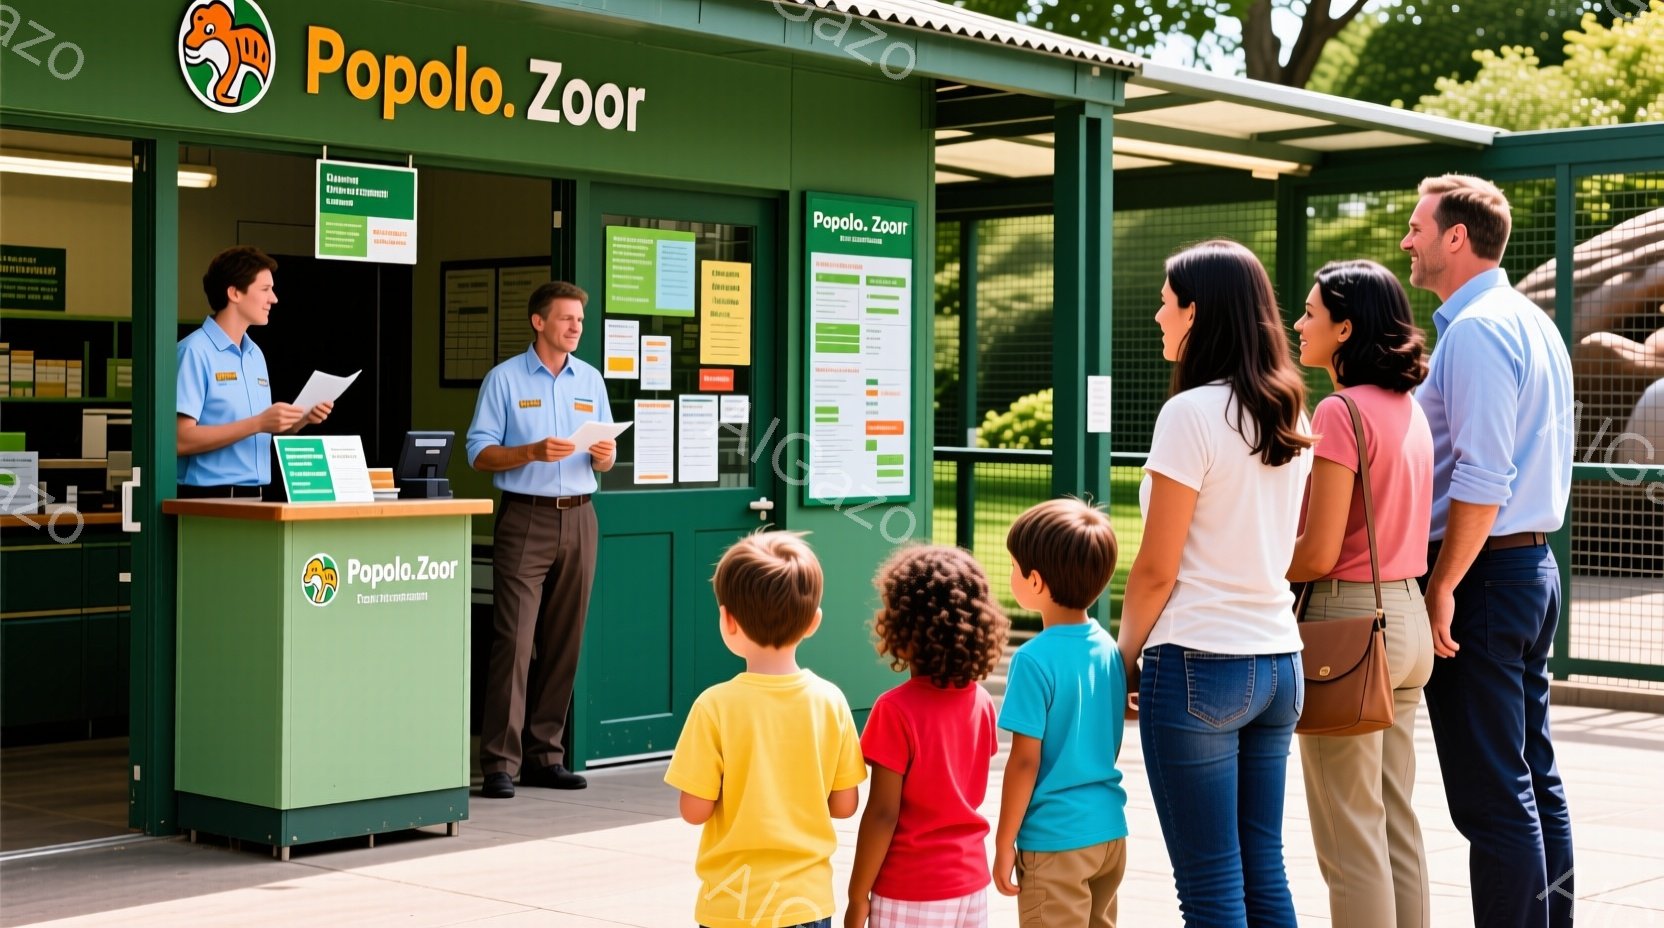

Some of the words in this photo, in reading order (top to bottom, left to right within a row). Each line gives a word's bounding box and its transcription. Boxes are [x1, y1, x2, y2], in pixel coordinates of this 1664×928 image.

[306, 25, 515, 120] Popolo.
[527, 58, 646, 132] Zoor
[813, 211, 868, 233] Popolo.
